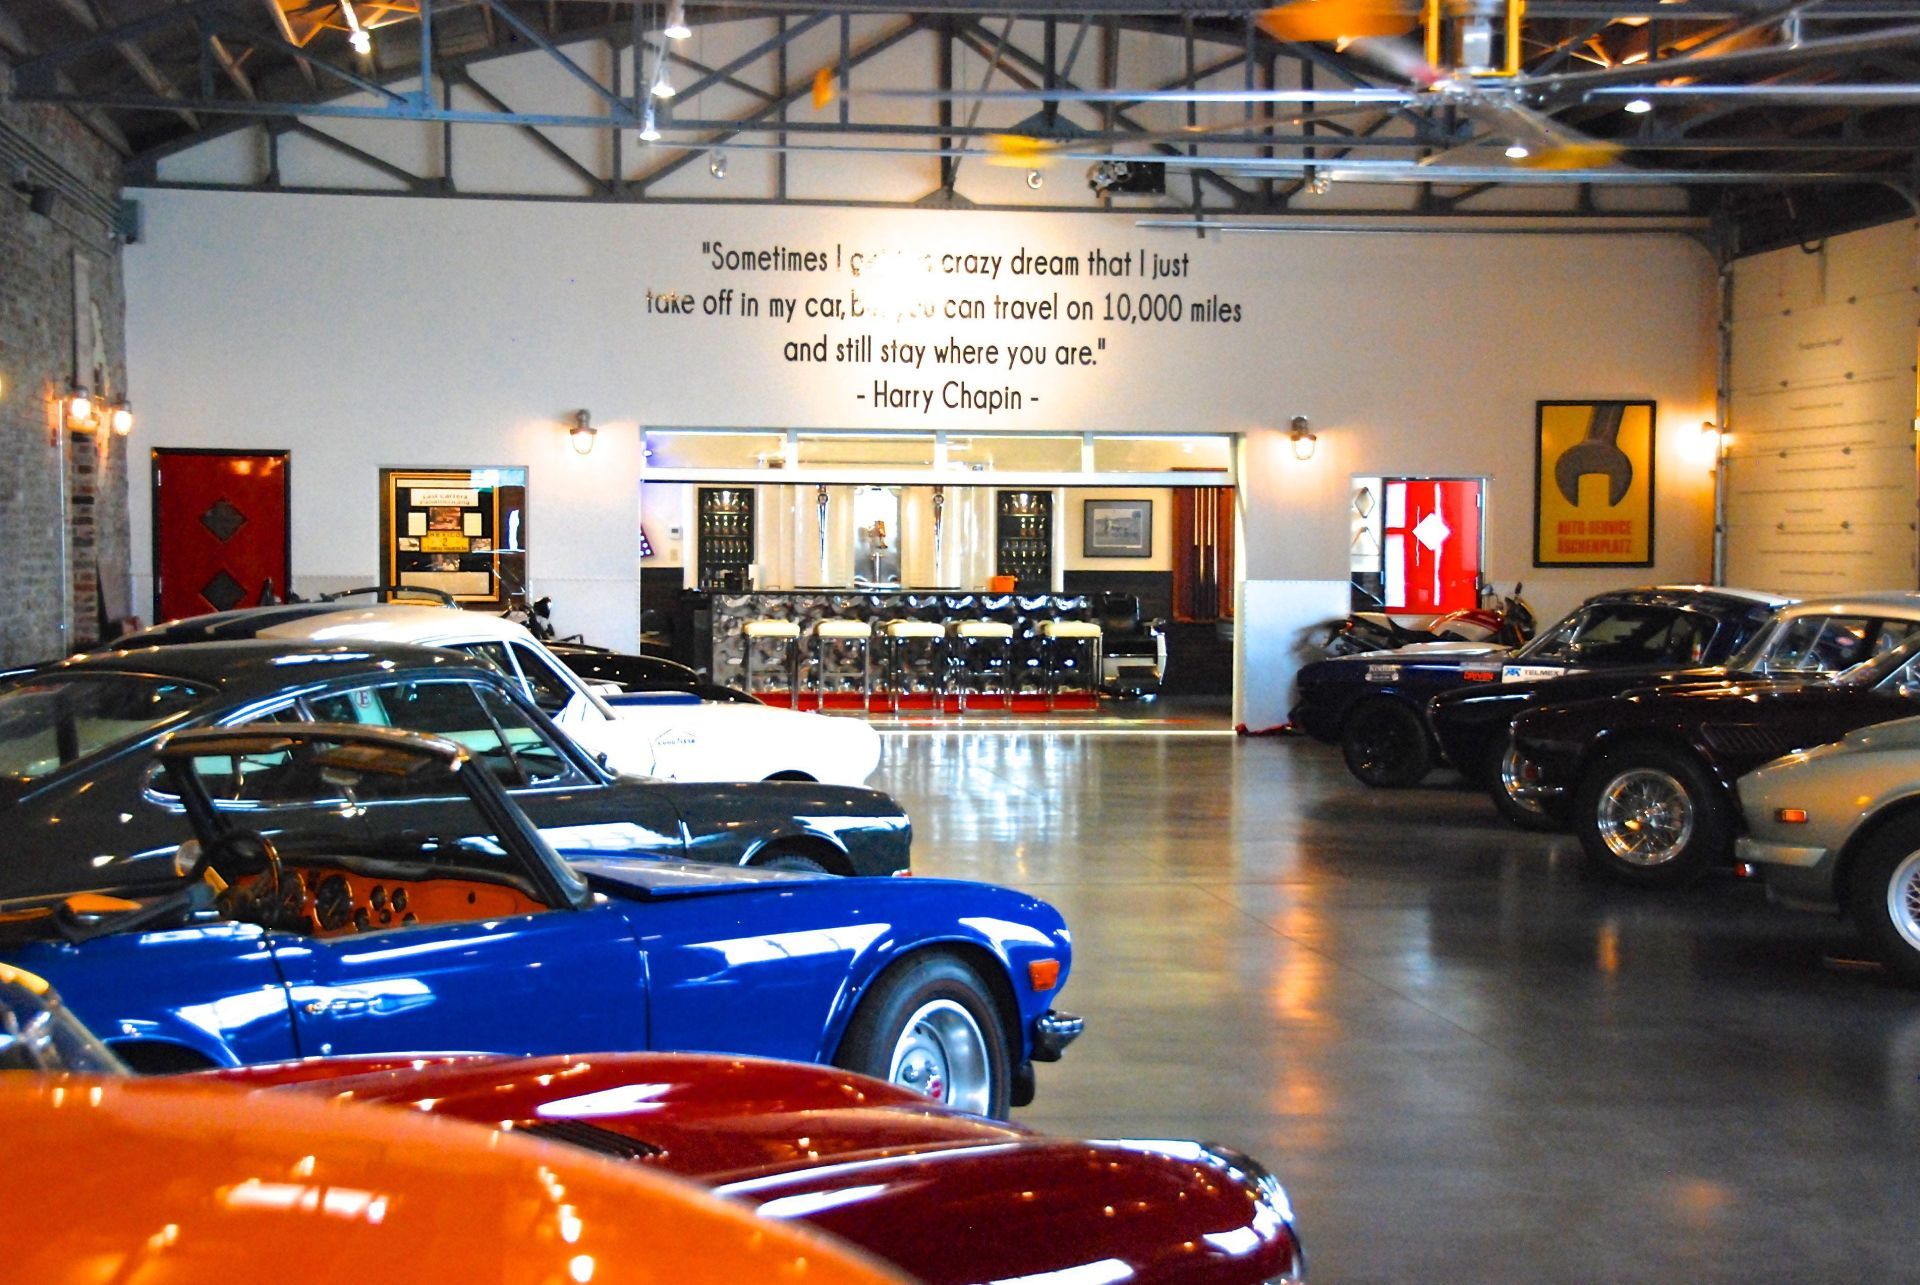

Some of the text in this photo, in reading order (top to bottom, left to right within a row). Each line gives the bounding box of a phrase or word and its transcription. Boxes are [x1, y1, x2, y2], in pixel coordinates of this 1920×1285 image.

[702, 242, 828, 272] "Sometimes
[941, 252, 1002, 280] crazy
[1010, 247, 1079, 277] dream
[1088, 249, 1132, 277] that
[1140, 250, 1145, 277] I
[1152, 252, 1189, 280] just
[645, 289, 695, 315] take
[703, 289, 734, 316] off
[741, 292, 759, 317] in
[769, 296, 796, 323] my
[805, 297, 845, 320] car,
[944, 298, 985, 320] can
[994, 292, 1058, 321] travel
[1066, 299, 1093, 321] on
[1102, 292, 1182, 324] 10,000
[1190, 294, 1242, 323] miles
[784, 334, 1106, 371] and still stay where you are."
[874, 379, 934, 414] Harry
[942, 380, 1022, 415] Chapin
[1525, 669, 1560, 677] TELMEX
